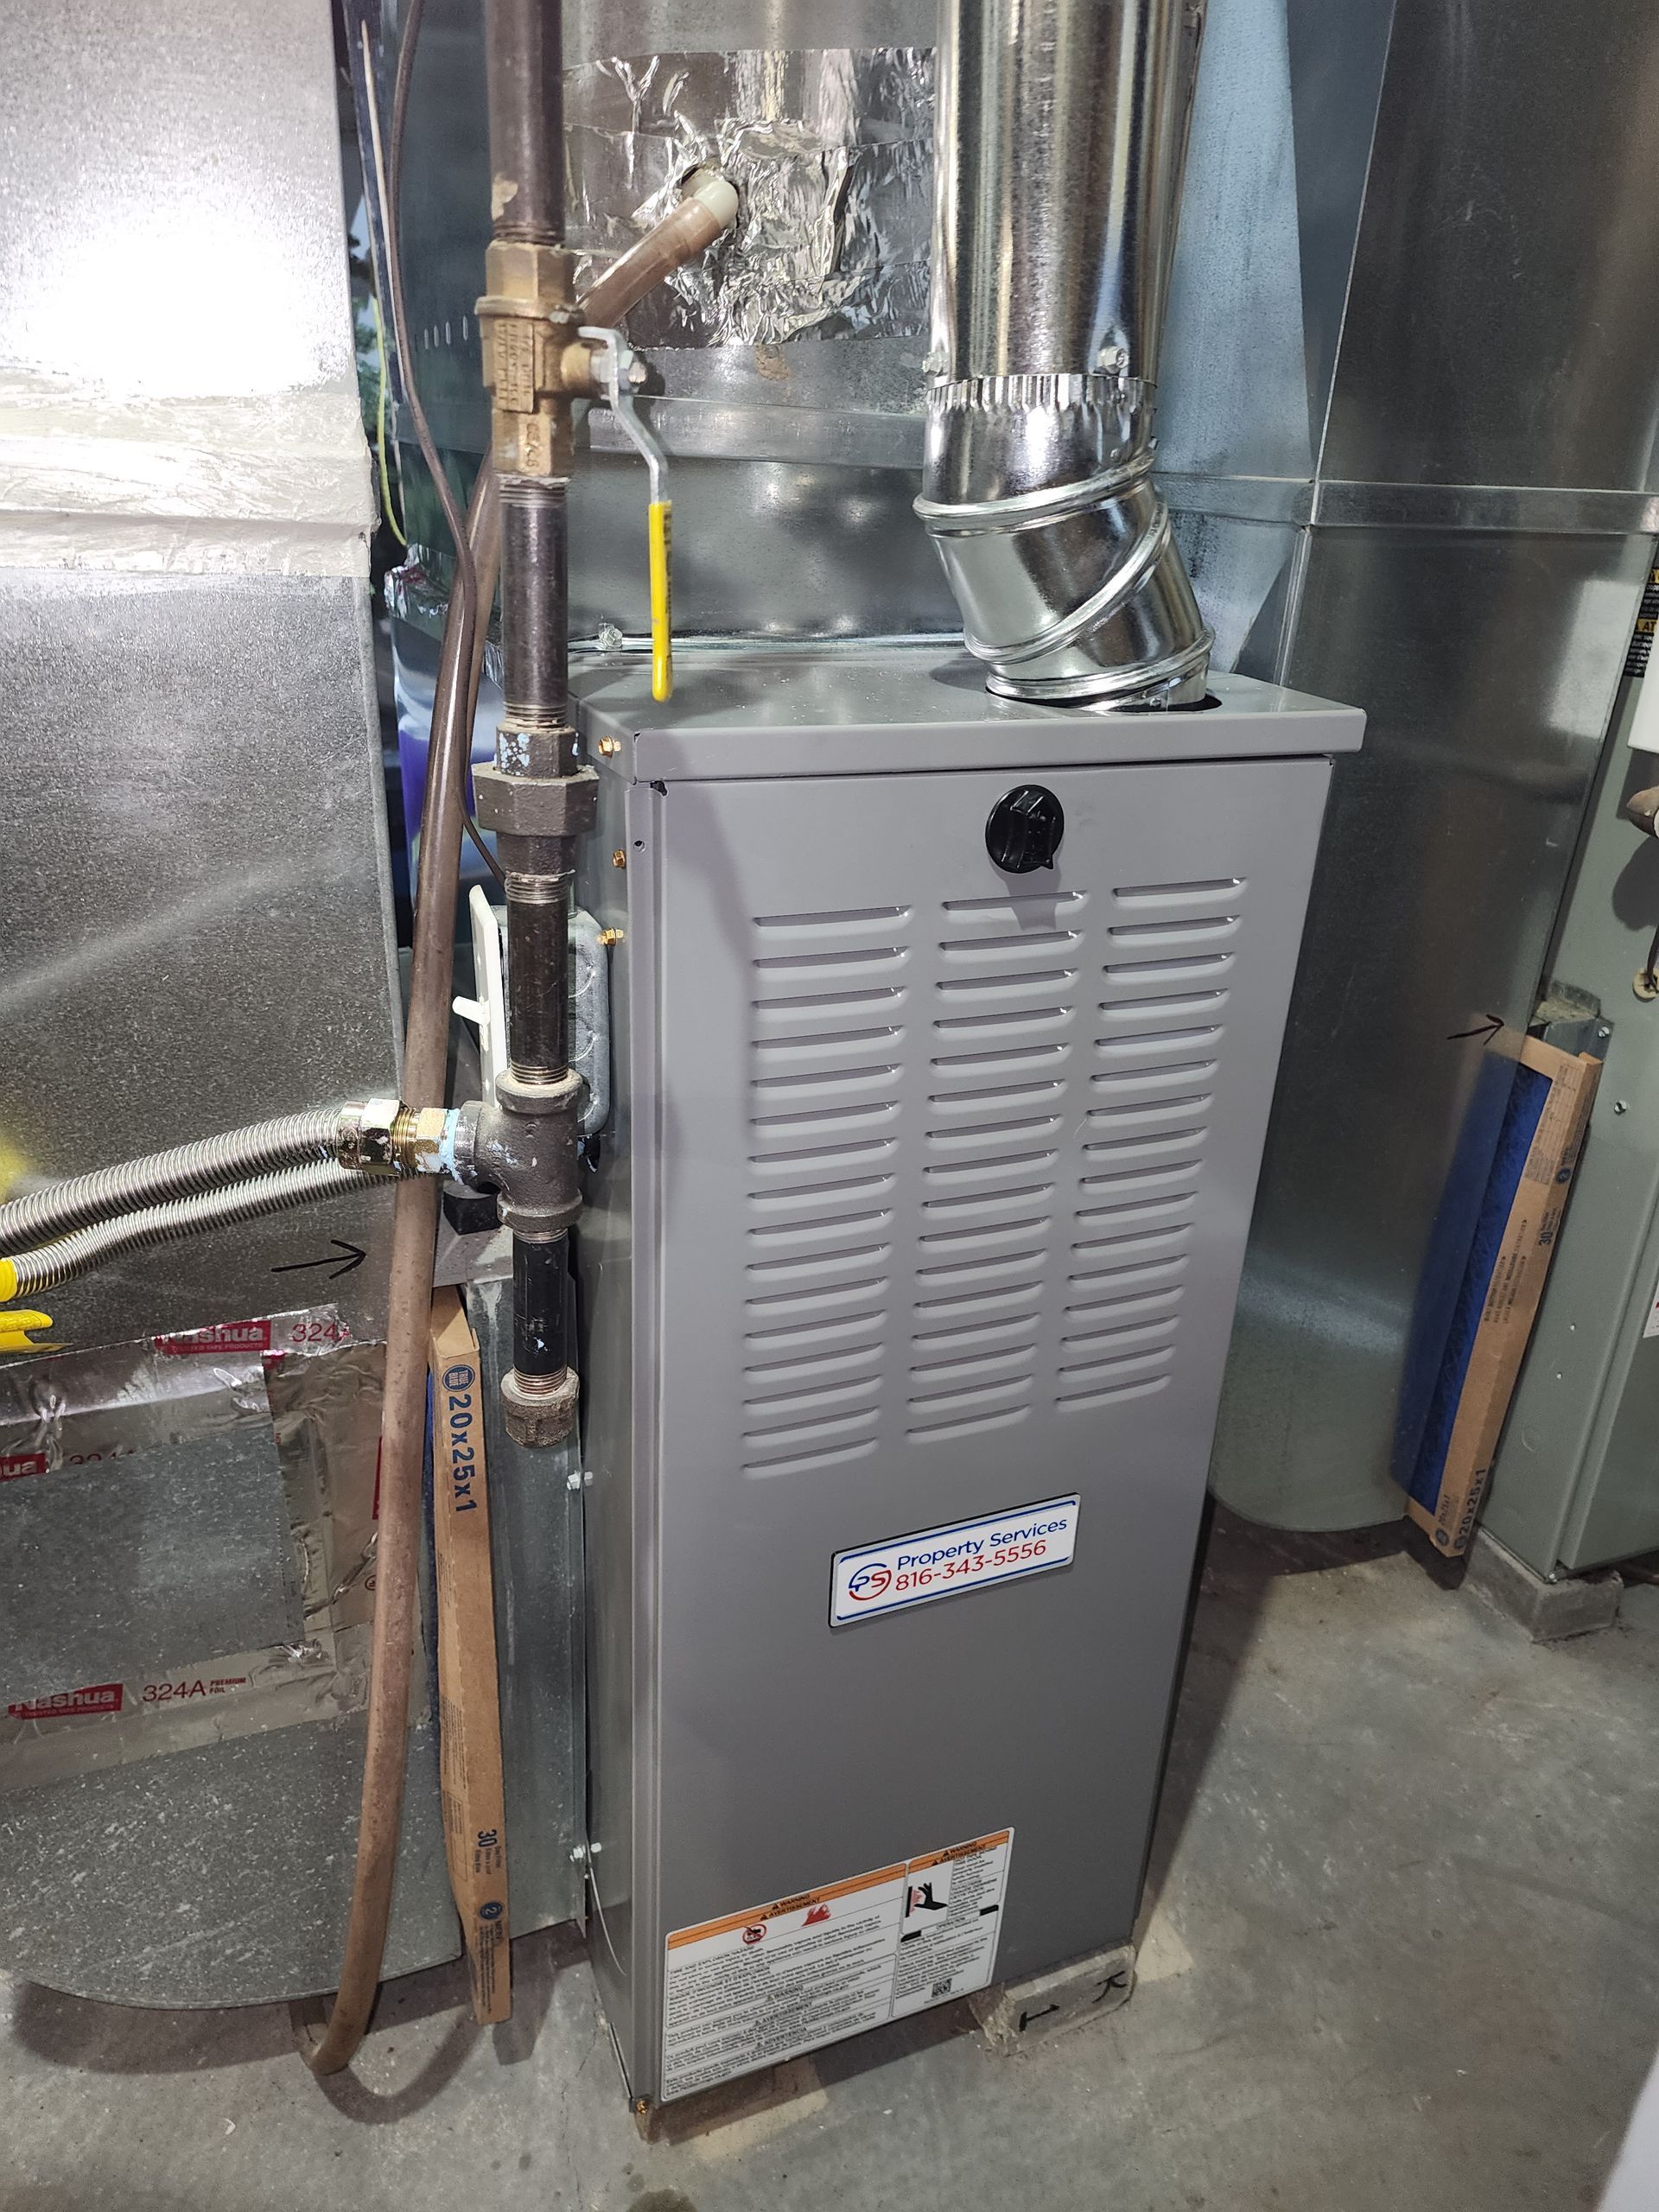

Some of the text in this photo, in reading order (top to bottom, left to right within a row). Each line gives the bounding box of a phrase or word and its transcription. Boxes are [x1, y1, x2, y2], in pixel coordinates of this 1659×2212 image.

[448, 1371, 460, 1387] BLUE
[458, 1369, 470, 1386] TRUE
[448, 1393, 478, 1512] 20x25x1
[1459, 1468, 1486, 1535] 20x25x1
[897, 1538, 985, 1571] Property
[989, 1517, 1067, 1548] Services
[895, 1539, 1047, 1592] 816-343-5556
[142, 1680, 207, 1702] 324A
[478, 1828, 498, 1847] 30
[485, 1906, 498, 1916] 2
